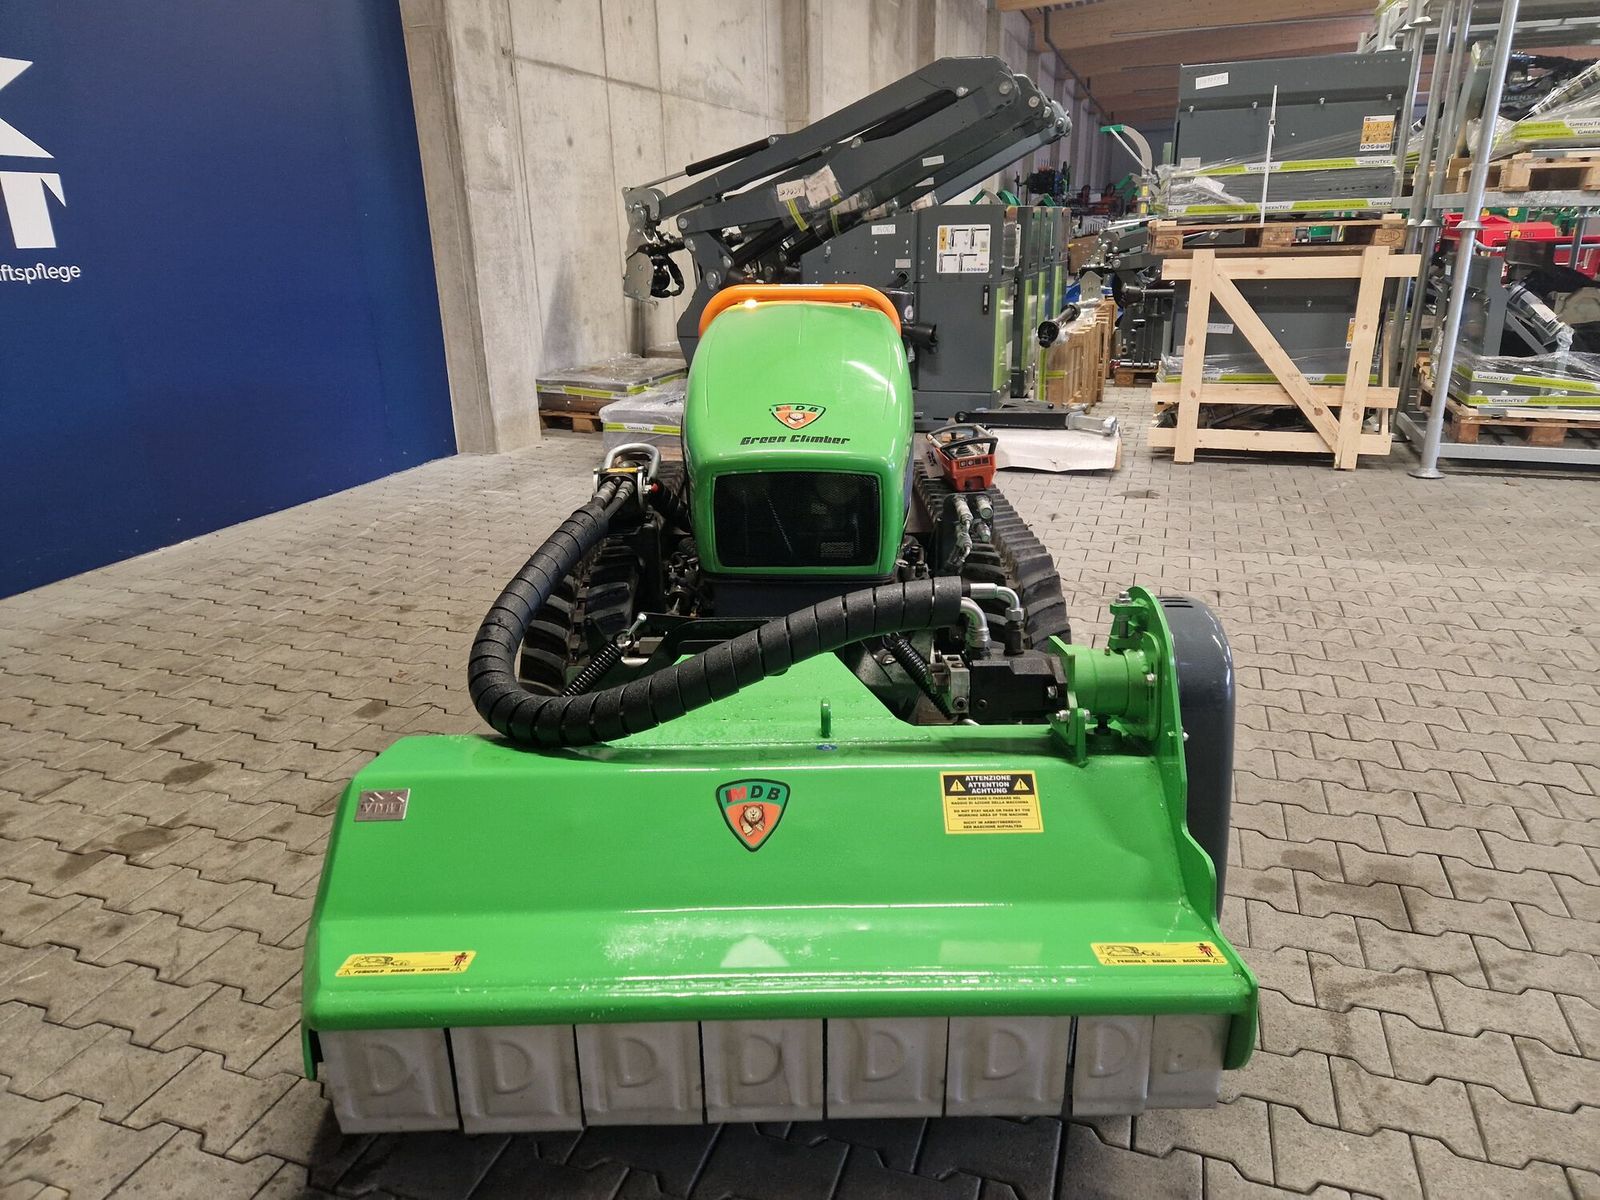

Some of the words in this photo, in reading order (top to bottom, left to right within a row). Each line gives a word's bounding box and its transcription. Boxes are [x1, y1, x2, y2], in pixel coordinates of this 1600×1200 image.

[0, 263, 81, 284] ftspflege
[740, 436, 787, 446] Green
[790, 435, 851, 444] Climber
[725, 785, 781, 802] MDB
